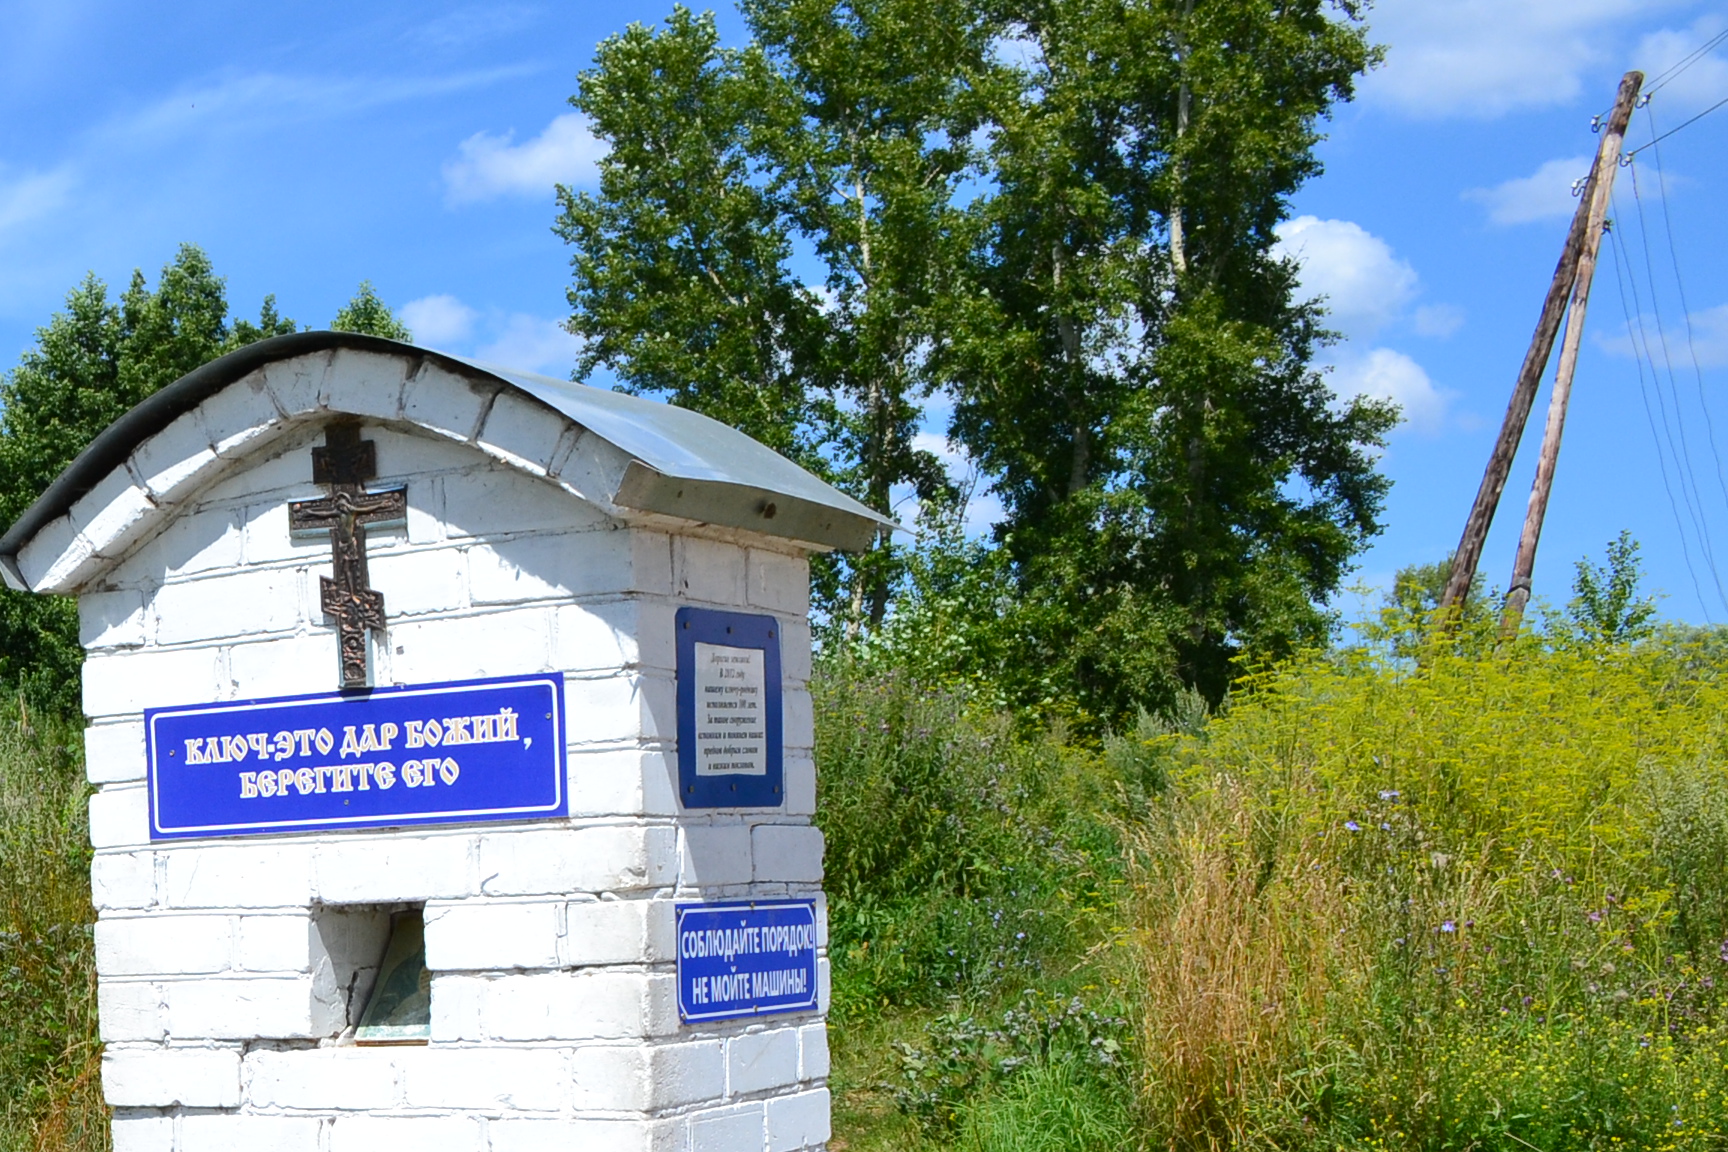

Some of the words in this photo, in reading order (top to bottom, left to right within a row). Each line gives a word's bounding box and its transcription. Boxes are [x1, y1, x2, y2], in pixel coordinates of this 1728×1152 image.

[339, 722, 399, 756] ДАР
[239, 761, 397, 799] БЕРЕГИТЕ
[401, 756, 460, 788] ЕГО
[681, 920, 760, 962] СОБЛЮДАЙТЕ
[762, 924, 813, 957] ПОРЯДОК!
[692, 976, 709, 1005] НЕ
[711, 966, 751, 1003] МОЙТЕ
[752, 968, 807, 999] МАШИНЫ!
